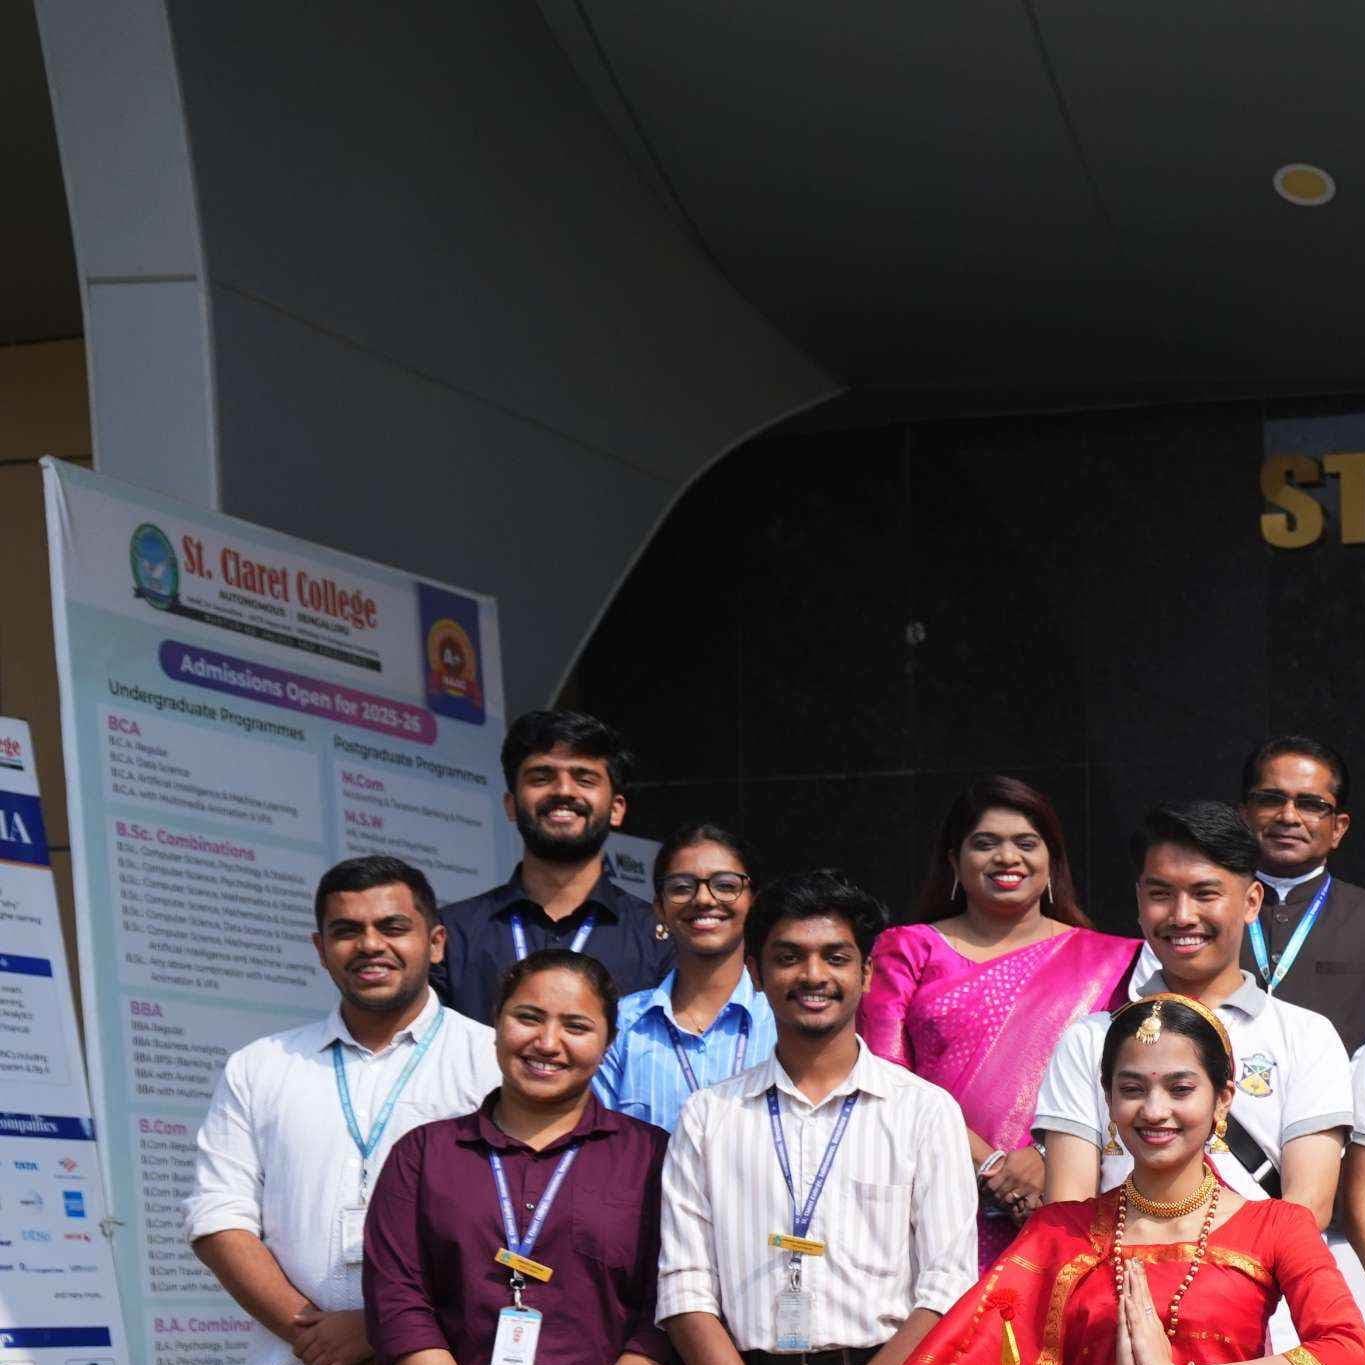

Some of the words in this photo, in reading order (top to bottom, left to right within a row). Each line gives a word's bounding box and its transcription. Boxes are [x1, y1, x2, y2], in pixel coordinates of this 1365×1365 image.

[182, 535, 212, 579] St.
[219, 546, 290, 602] Claret
[296, 568, 378, 630] College
[108, 677, 217, 720] Undergraduate
[219, 707, 306, 741] Programmes
[181, 654, 282, 696] Admissions
[286, 681, 332, 709] Open
[335, 694, 358, 715] for
[361, 702, 423, 732] 2025-26
[107, 714, 142, 737] BCA
[334, 733, 413, 768] Postgraduate
[416, 756, 488, 786] Programmes
[115, 821, 152, 842] B.Sc.
[156, 828, 256, 862] Combinations
[130, 1000, 163, 1018] BBA
[0, 1119, 58, 1134] ompanies
[139, 1117, 187, 1136] B.Com
[188, 1315, 256, 1333] Combina
